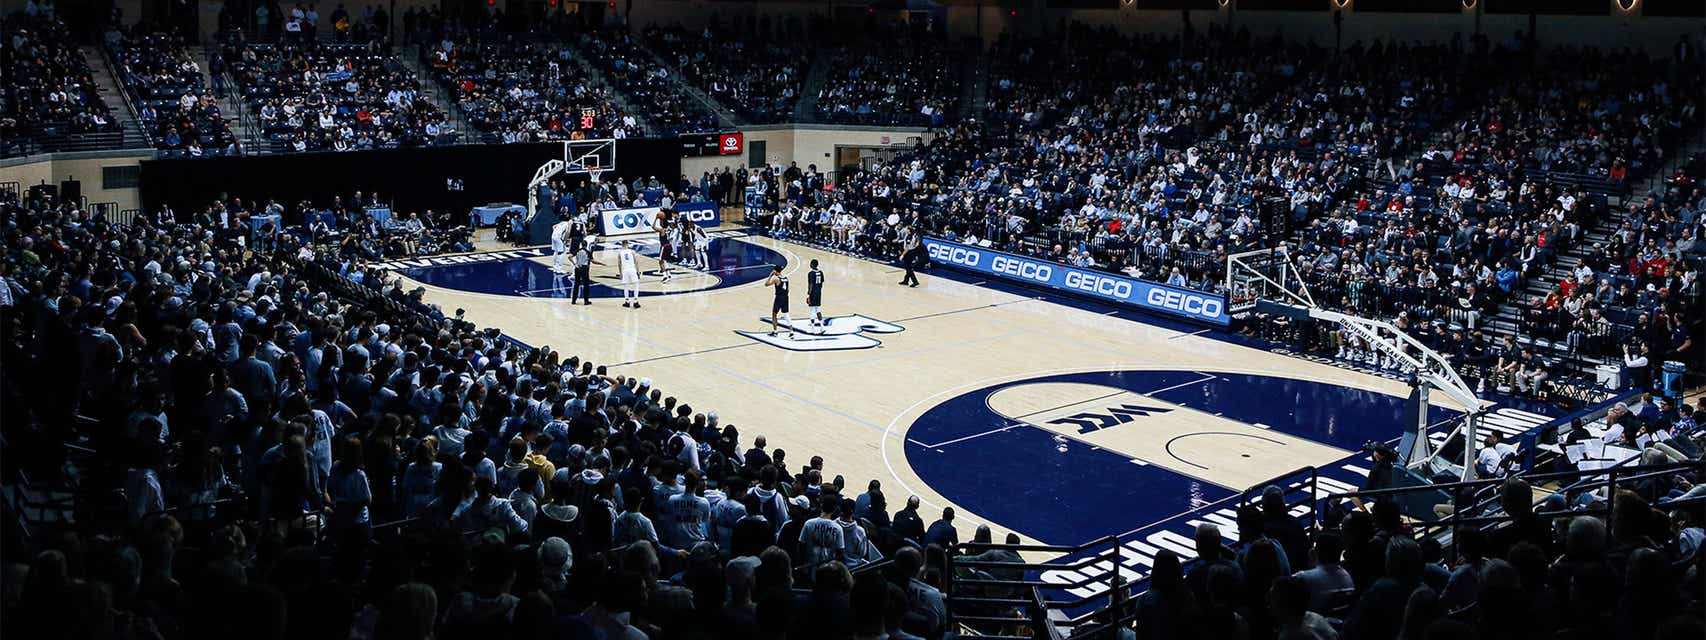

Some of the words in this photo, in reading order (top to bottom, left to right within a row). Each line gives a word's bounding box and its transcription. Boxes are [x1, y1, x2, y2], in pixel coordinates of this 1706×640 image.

[581, 116, 593, 129] 30
[613, 211, 652, 230] COX
[679, 208, 715, 222] ICO
[366, 249, 546, 271] NIVERSITY
[926, 242, 980, 267] GEICO
[991, 256, 1052, 282] GEICO
[1065, 270, 1132, 299] GEICO
[1147, 288, 1222, 318] GEICO
[814, 523, 838, 536] HOME
